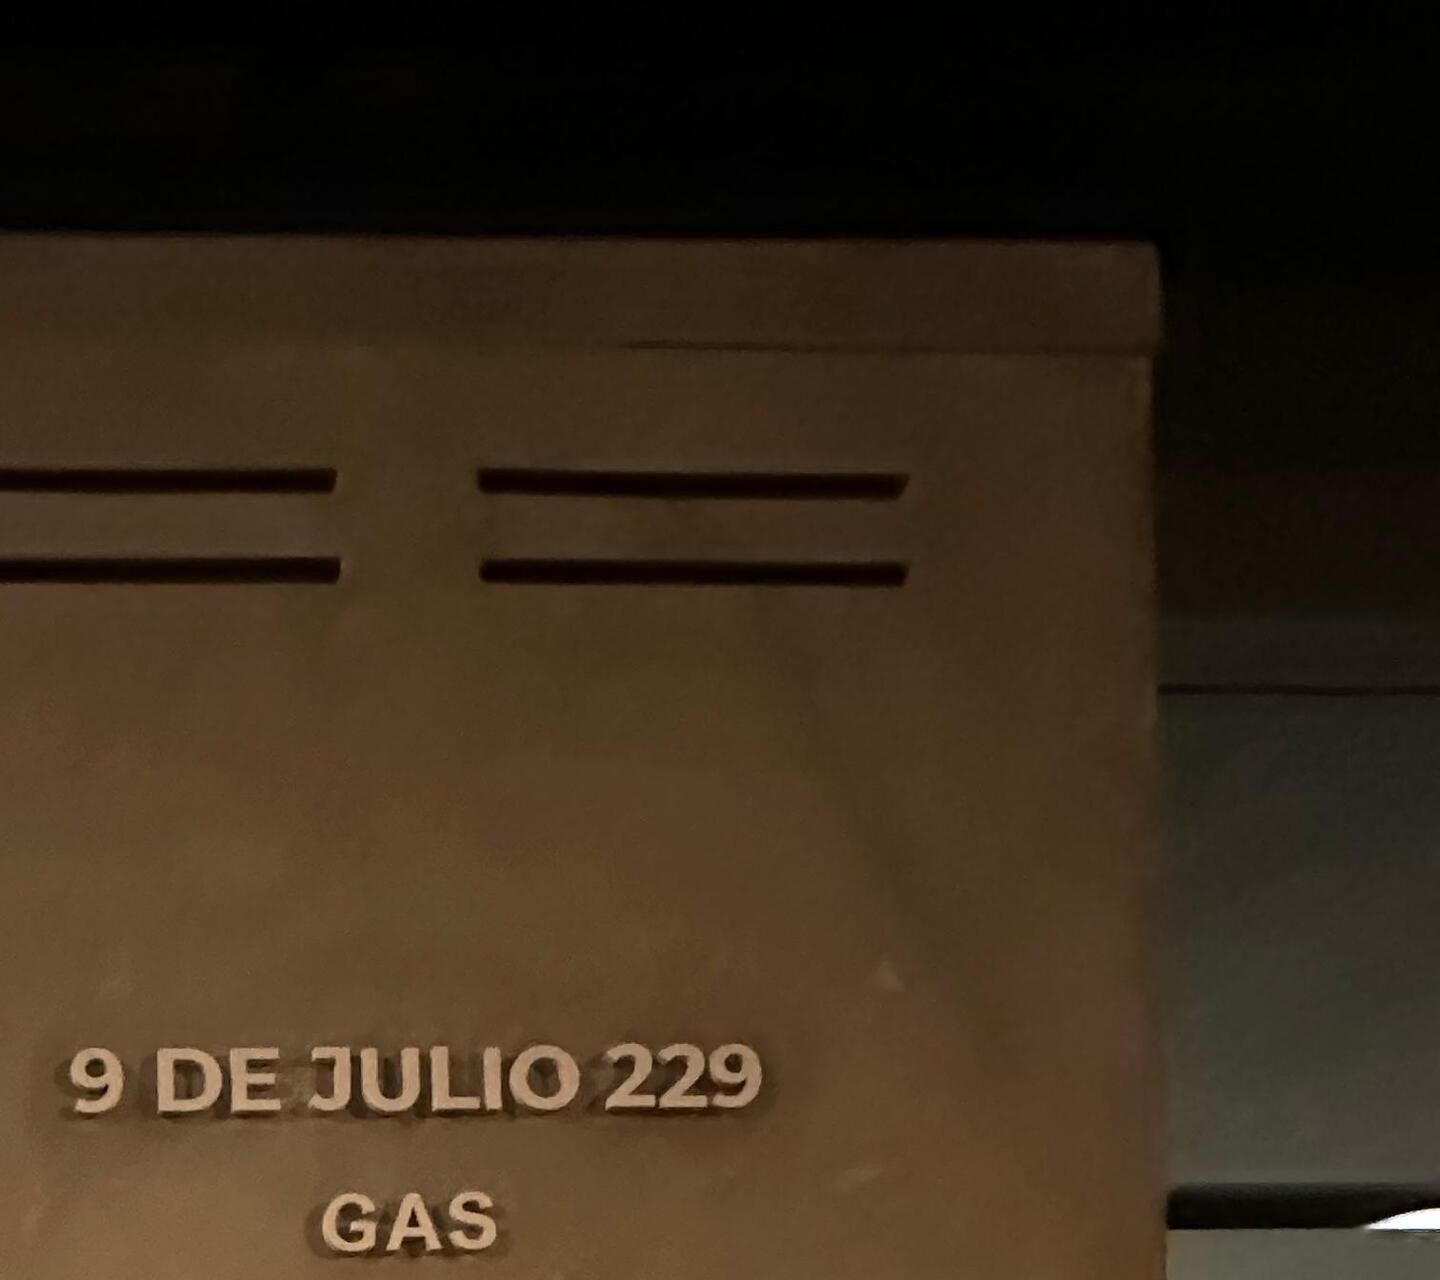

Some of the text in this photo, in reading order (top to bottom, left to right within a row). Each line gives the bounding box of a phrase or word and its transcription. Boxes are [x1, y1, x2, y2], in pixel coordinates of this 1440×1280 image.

[69, 1042, 762, 1114] 9 DE JULIO 229
[321, 1191, 497, 1254] GAS
